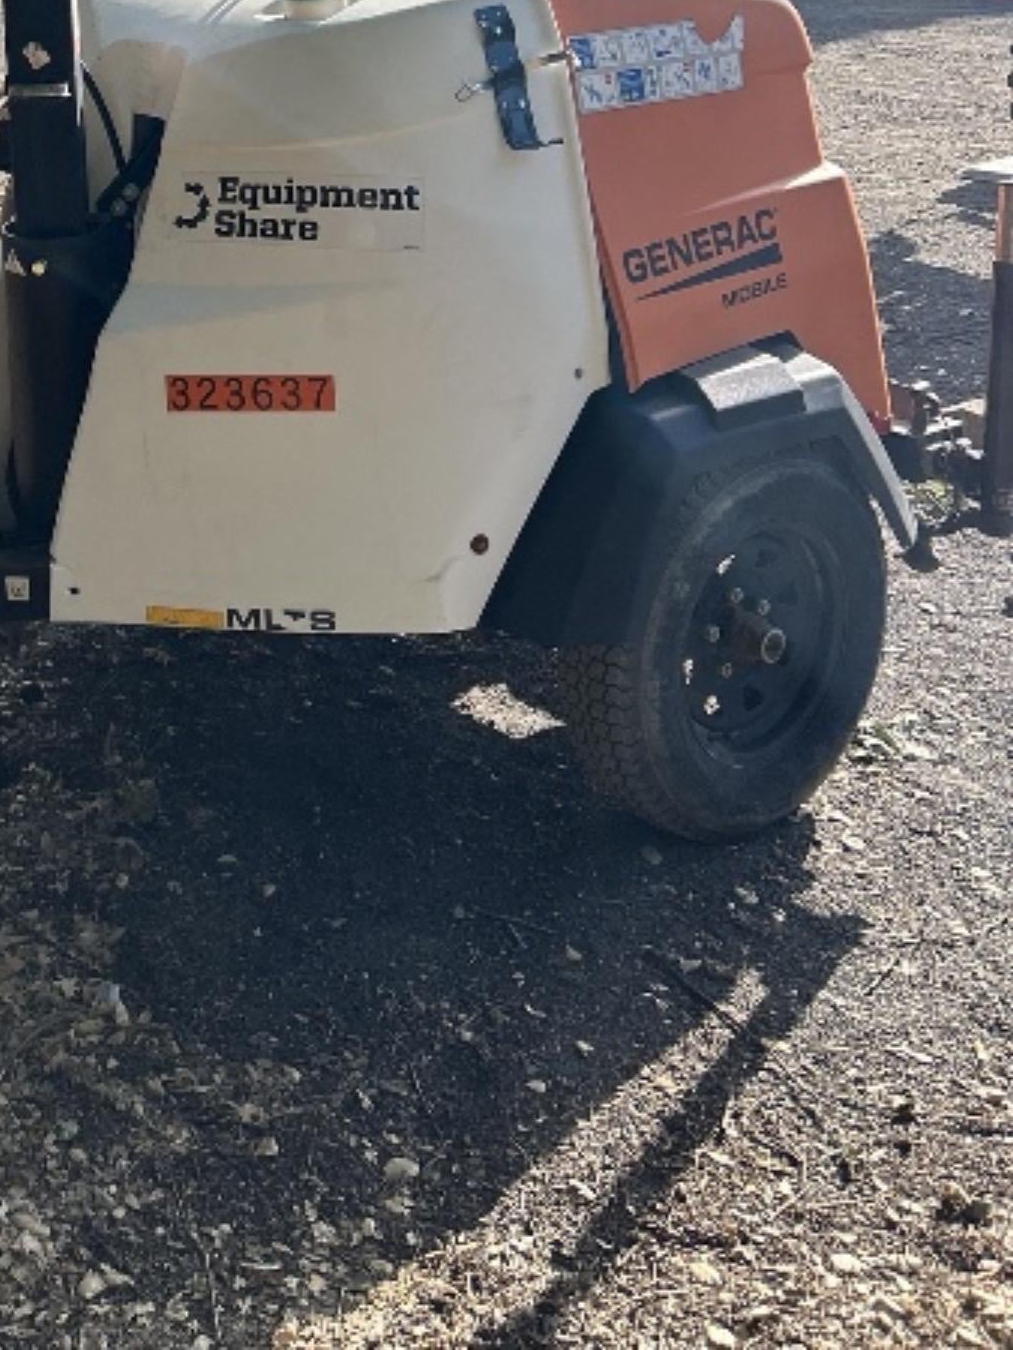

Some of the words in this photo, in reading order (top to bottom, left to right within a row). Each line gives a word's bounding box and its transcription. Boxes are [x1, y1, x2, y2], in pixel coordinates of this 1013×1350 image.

[217, 176, 420, 213] Equipment
[214, 209, 319, 240] Share
[623, 208, 778, 283] GENERAC
[721, 273, 788, 307] MOBILE
[170, 377, 328, 411] 323637
